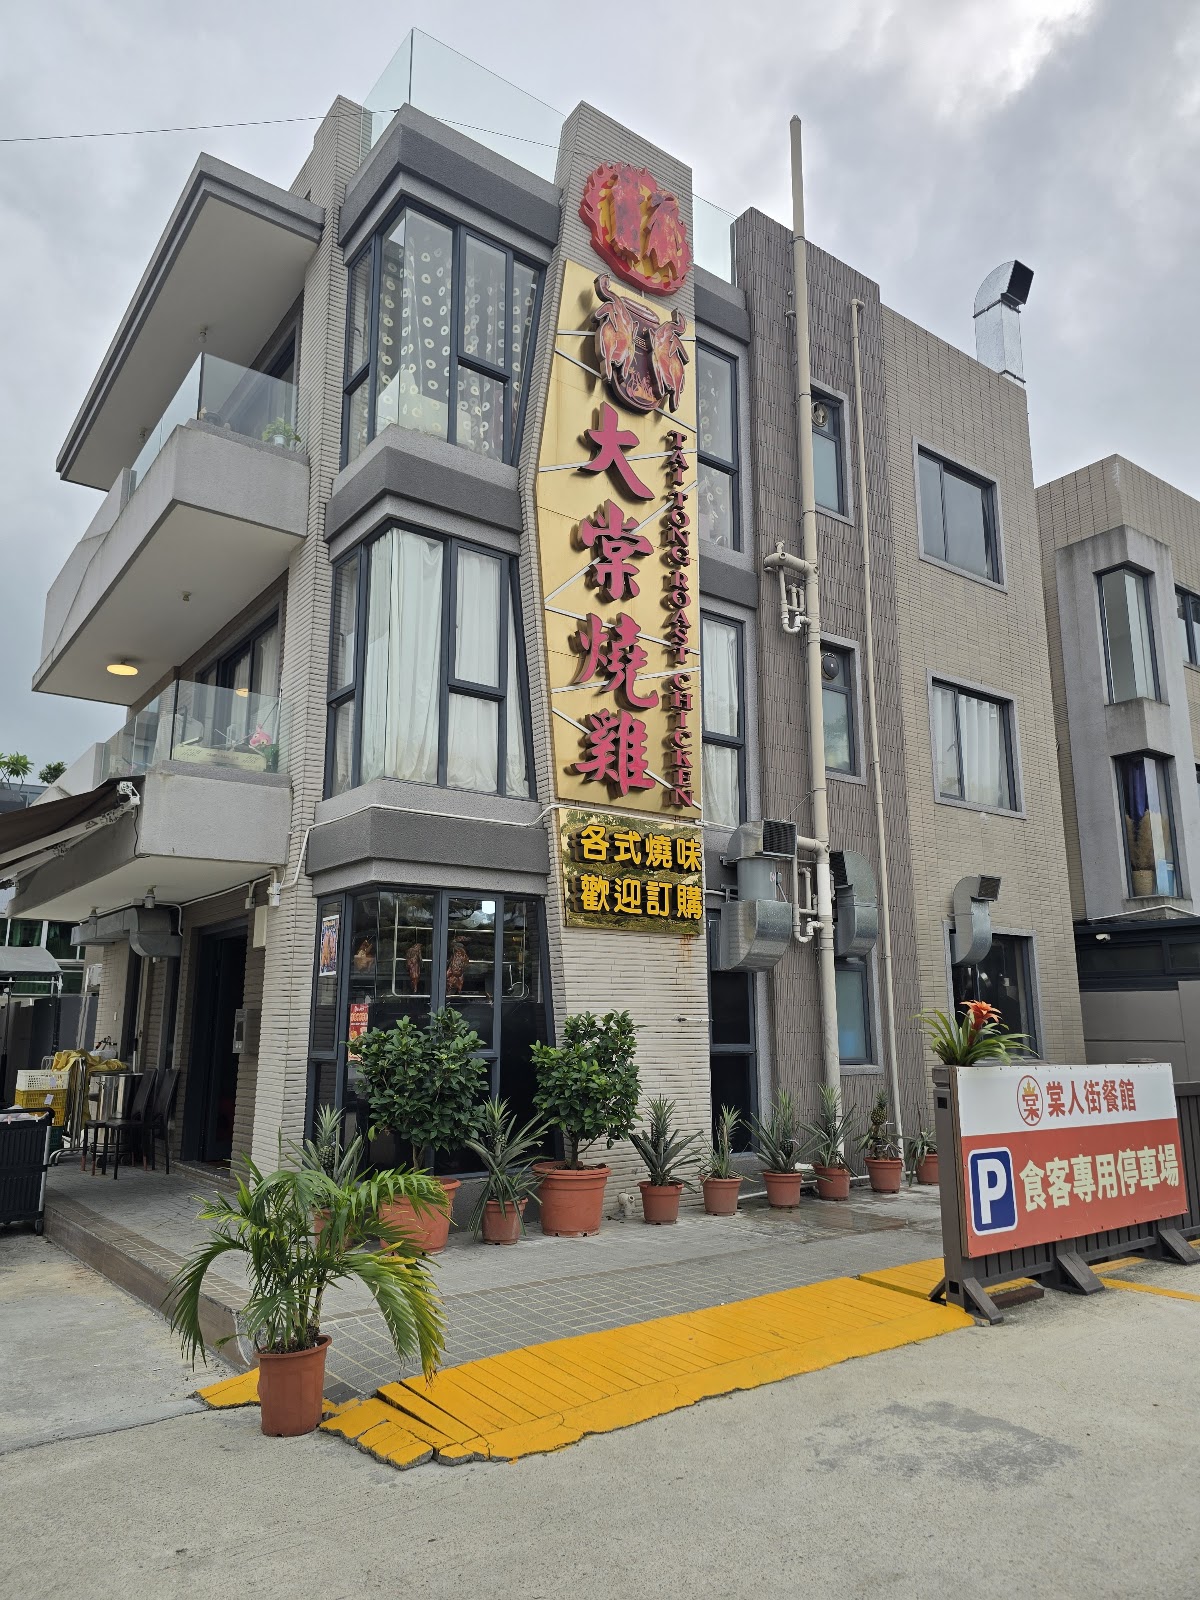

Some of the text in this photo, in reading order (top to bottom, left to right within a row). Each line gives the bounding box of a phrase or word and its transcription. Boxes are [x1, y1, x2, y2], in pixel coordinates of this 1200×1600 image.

[667, 430, 693, 807] TAI TONG ROAST CHICKEN
[581, 824, 702, 872] 各式燒味
[581, 873, 703, 920] 歡迎訂購
[1046, 1079, 1137, 1117] 棠人街餐館
[977, 1158, 1007, 1224] P
[1019, 1144, 1180, 1212] 食客專用停車場
